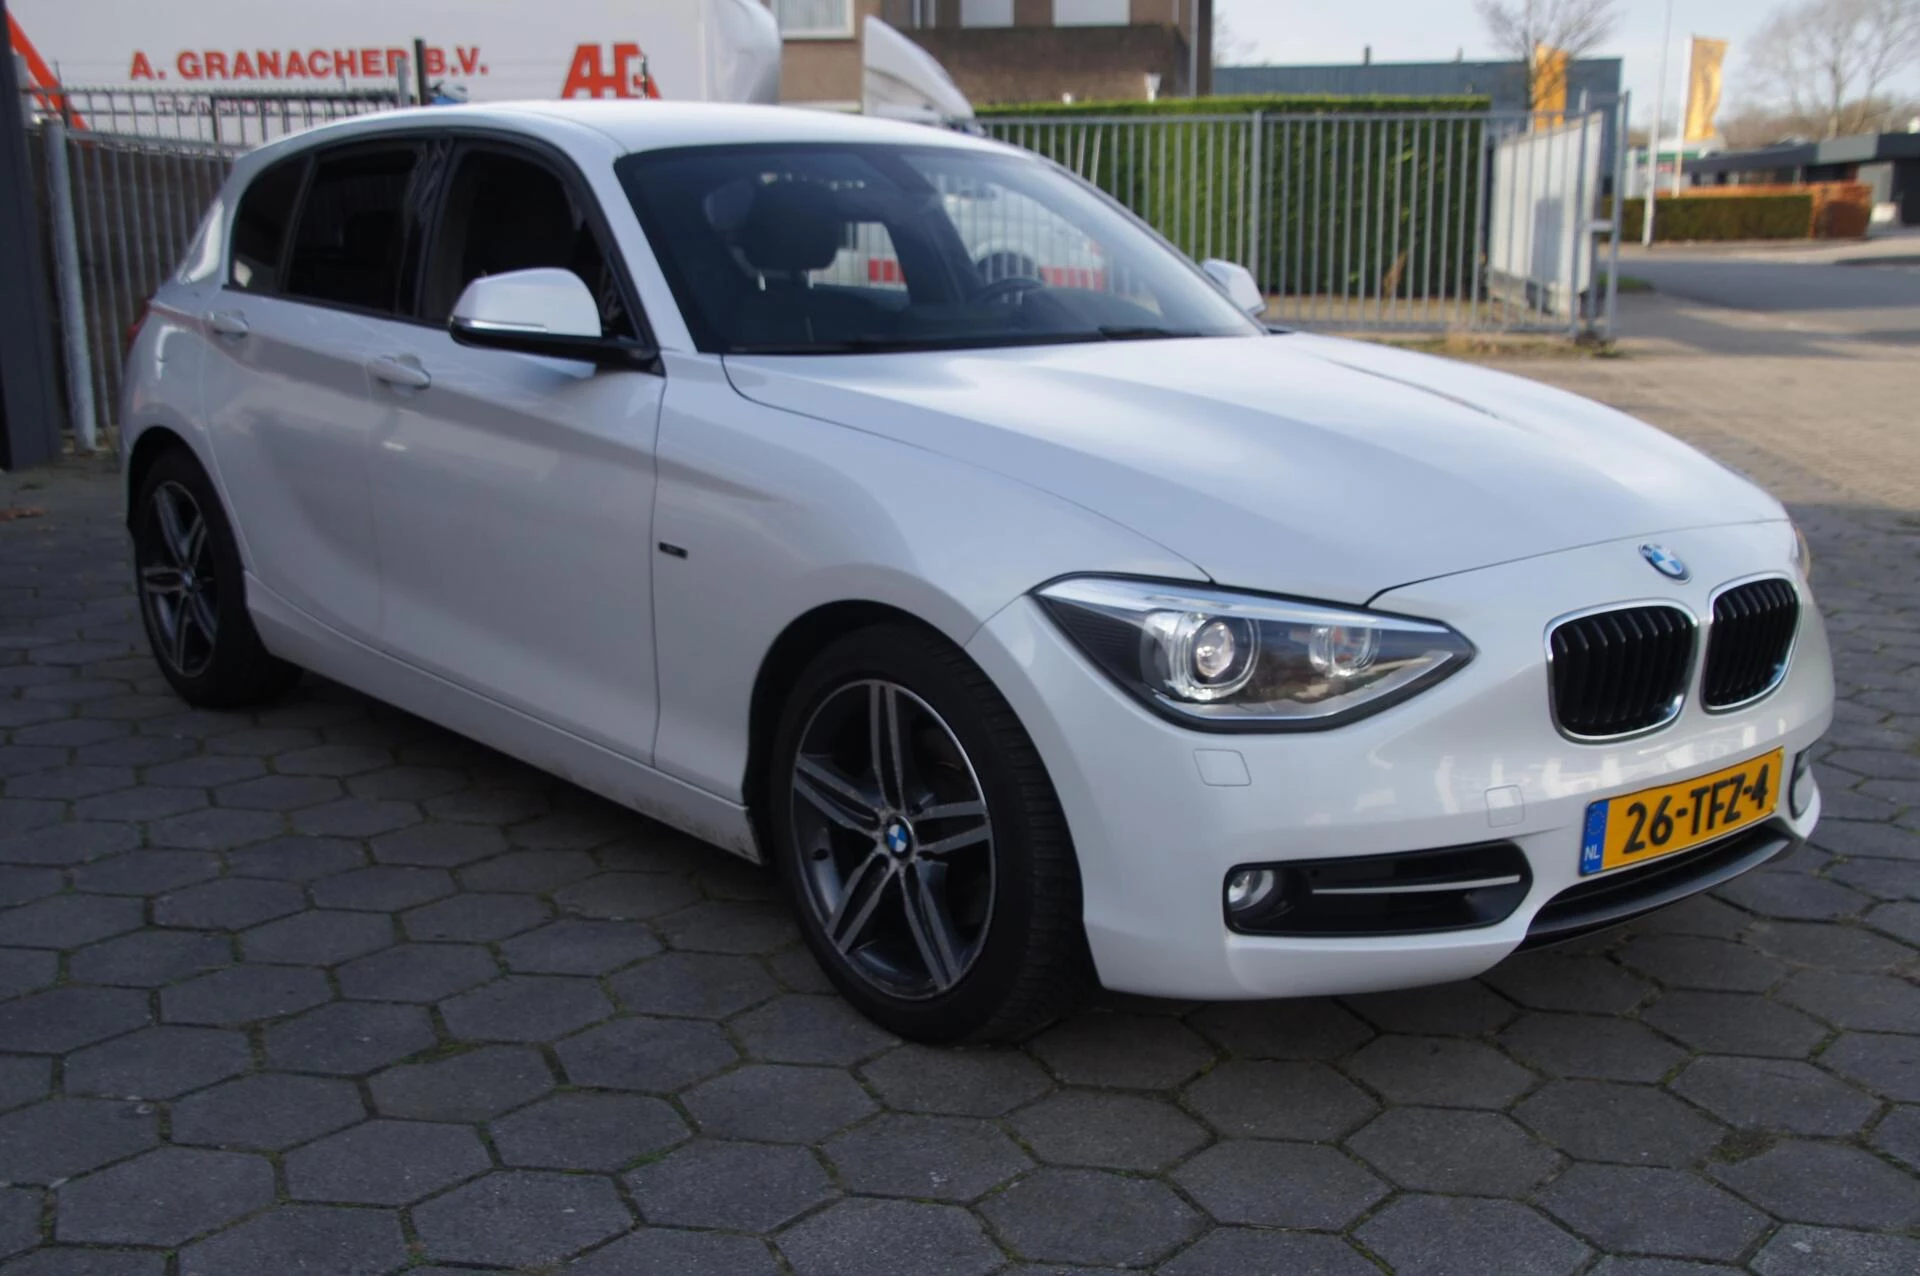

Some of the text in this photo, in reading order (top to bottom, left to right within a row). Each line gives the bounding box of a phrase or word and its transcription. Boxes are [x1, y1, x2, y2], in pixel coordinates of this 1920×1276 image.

[129, 50, 167, 80] A.
[424, 46, 489, 77] B.V.
[1621, 763, 1770, 855] 26-TFZ-4
[1583, 844, 1600, 861] NL
